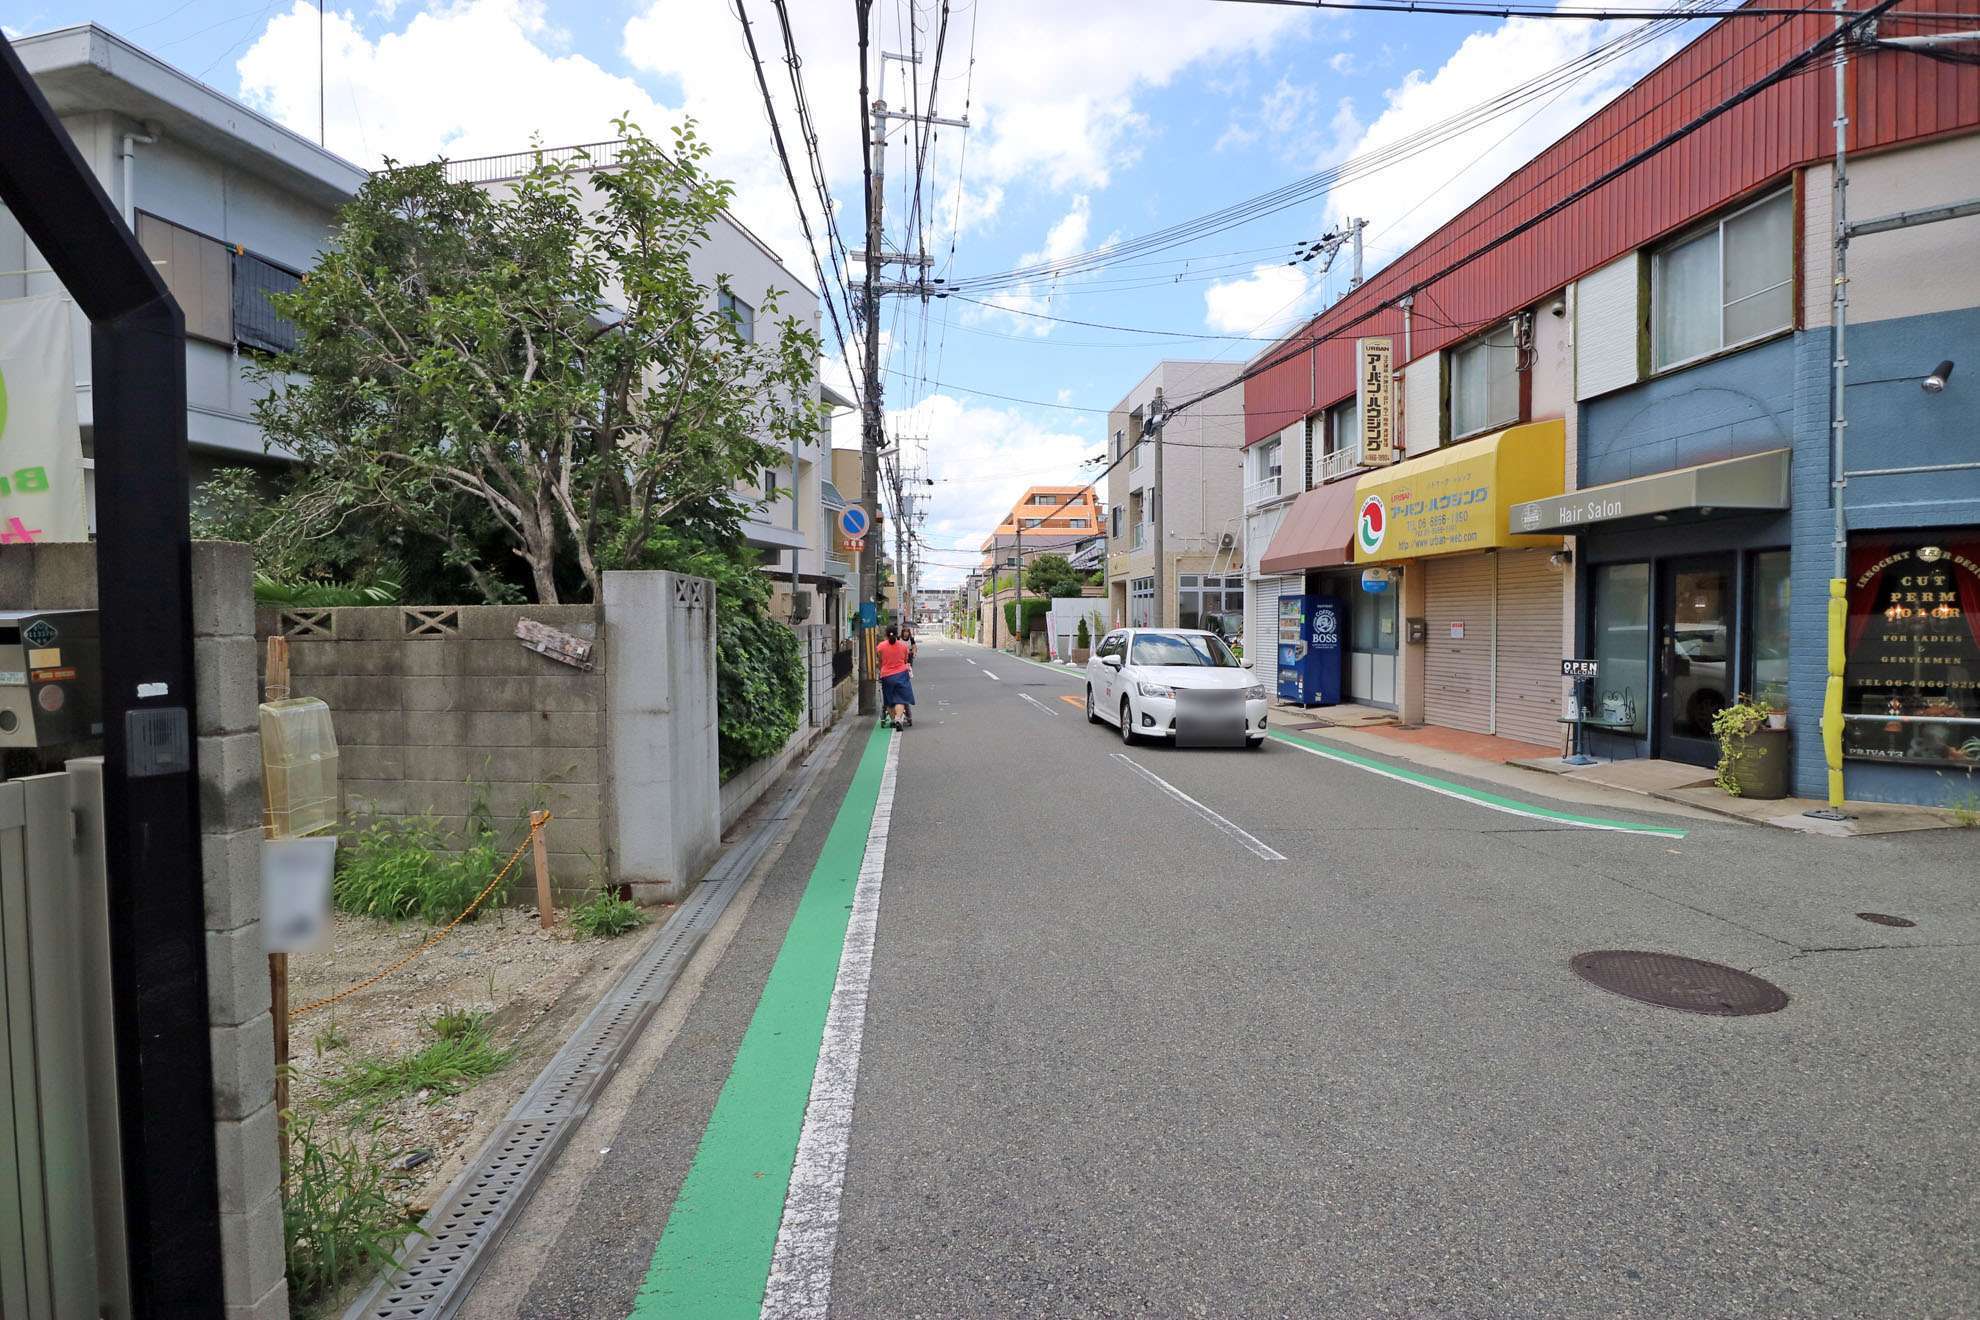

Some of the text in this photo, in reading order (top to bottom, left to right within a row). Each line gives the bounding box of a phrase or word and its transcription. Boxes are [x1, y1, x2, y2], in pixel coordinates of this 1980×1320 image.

[1559, 505, 1583, 524] Hair
[1587, 499, 1622, 520] Salon
[1856, 551, 1911, 589] INNOCENT
[1901, 575, 1947, 586] CUT
[1890, 592, 1957, 602] PERM
[1312, 633, 1338, 643] BOSS
[1880, 656, 1962, 664] GENTLEMEN
[1563, 662, 1598, 671] OPEN
[1857, 678, 1882, 686] TEL
